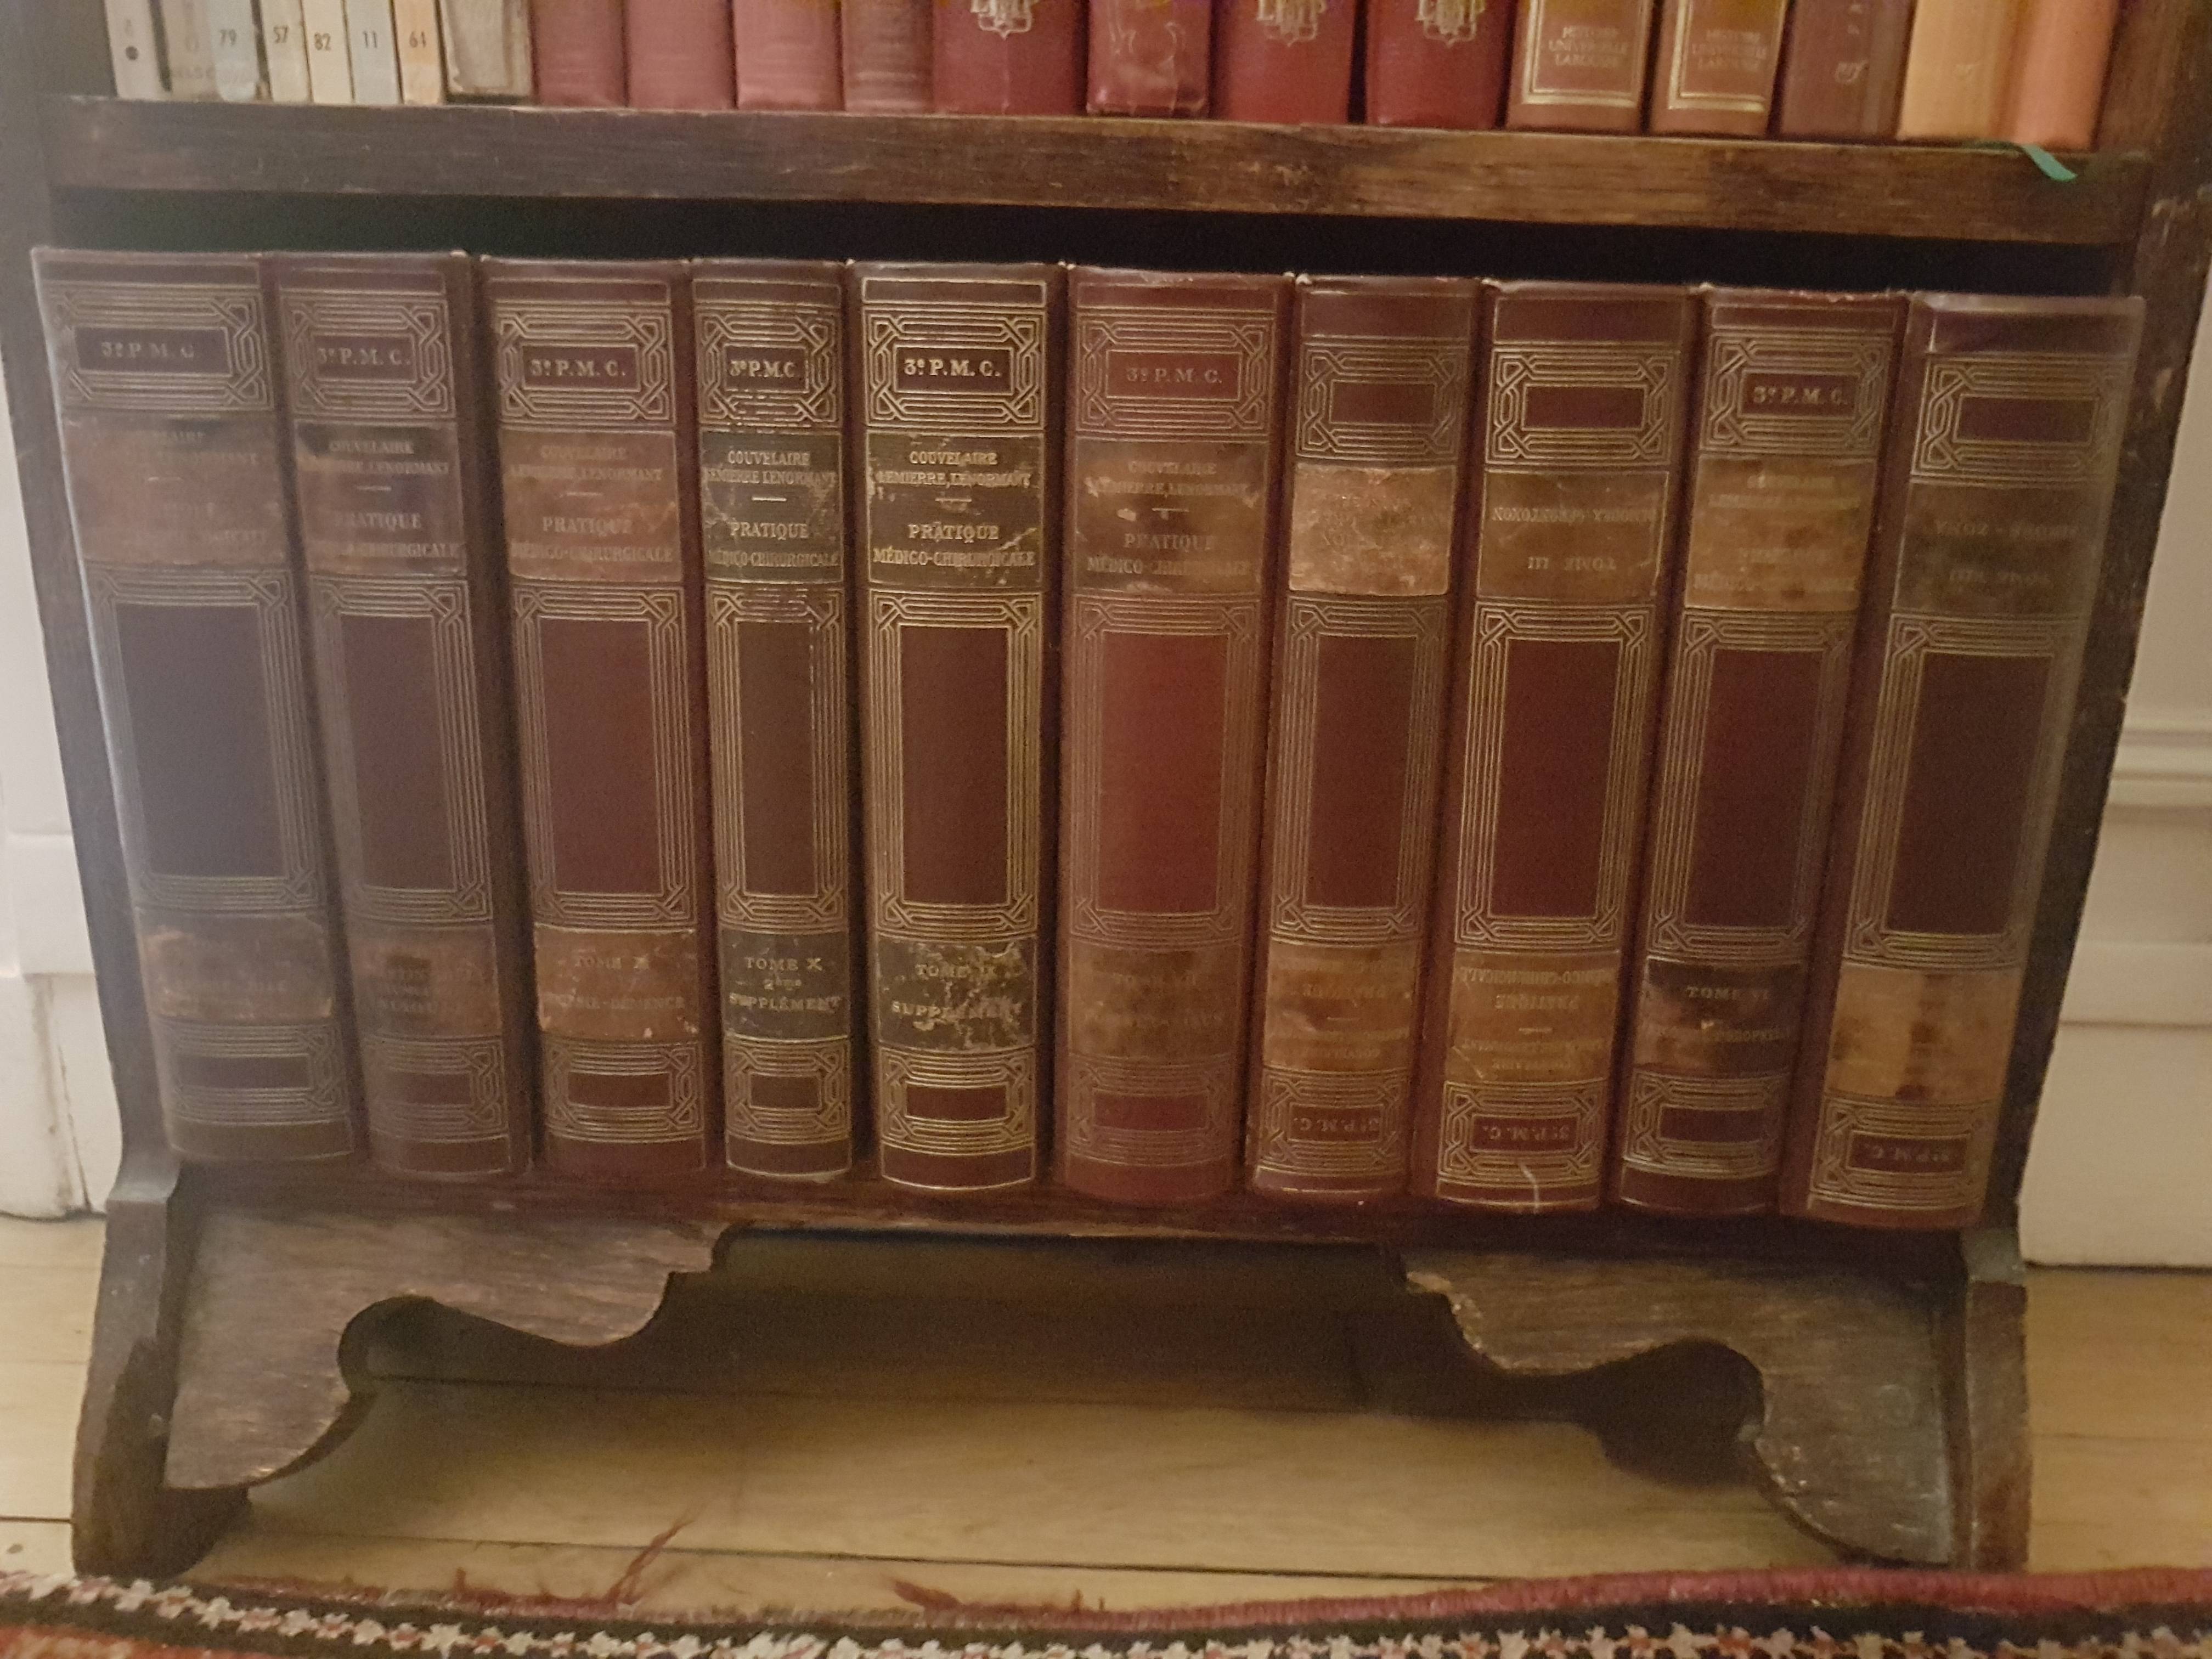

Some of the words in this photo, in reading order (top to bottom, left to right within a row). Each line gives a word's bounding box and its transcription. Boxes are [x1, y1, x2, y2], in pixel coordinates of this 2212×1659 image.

[314, 32, 331, 51] 82
[362, 30, 377, 49] 11
[727, 450, 811, 466] COUVELAIRE
[909, 450, 999, 466] COUVELAIRE
[729, 521, 810, 541] PRATIQUE
[907, 523, 1000, 544] PRATIQUE
[744, 956, 799, 971] TOME
[805, 956, 823, 972] X
